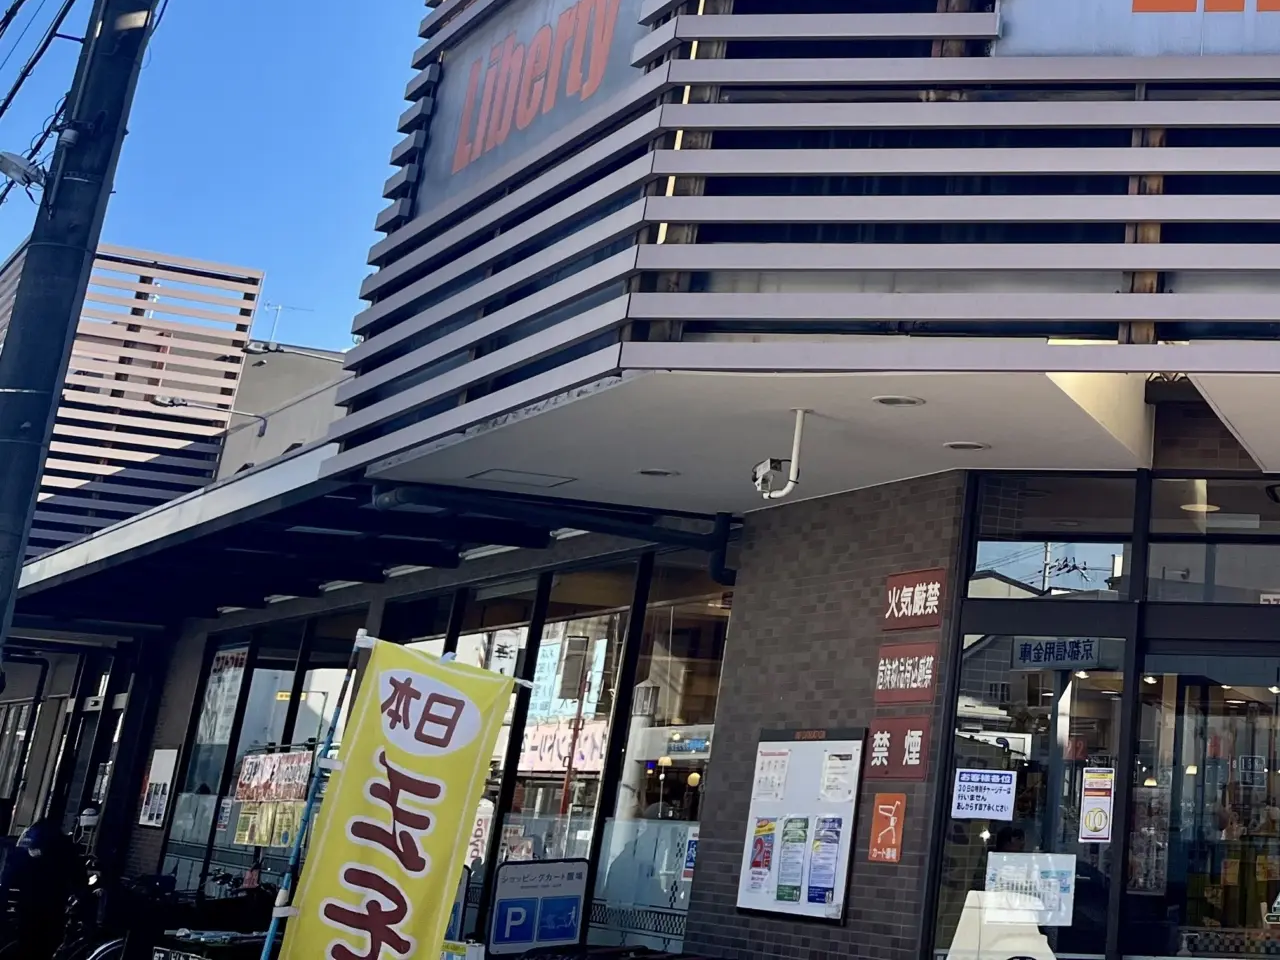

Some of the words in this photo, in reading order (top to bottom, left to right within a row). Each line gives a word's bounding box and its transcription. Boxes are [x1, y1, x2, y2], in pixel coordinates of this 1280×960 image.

[885, 582, 940, 618] 火気厳禁
[871, 729, 923, 766] 禁煙
[960, 773, 1011, 784] お客様各位
[957, 793, 988, 802] 行いません
[504, 907, 527, 938] P
